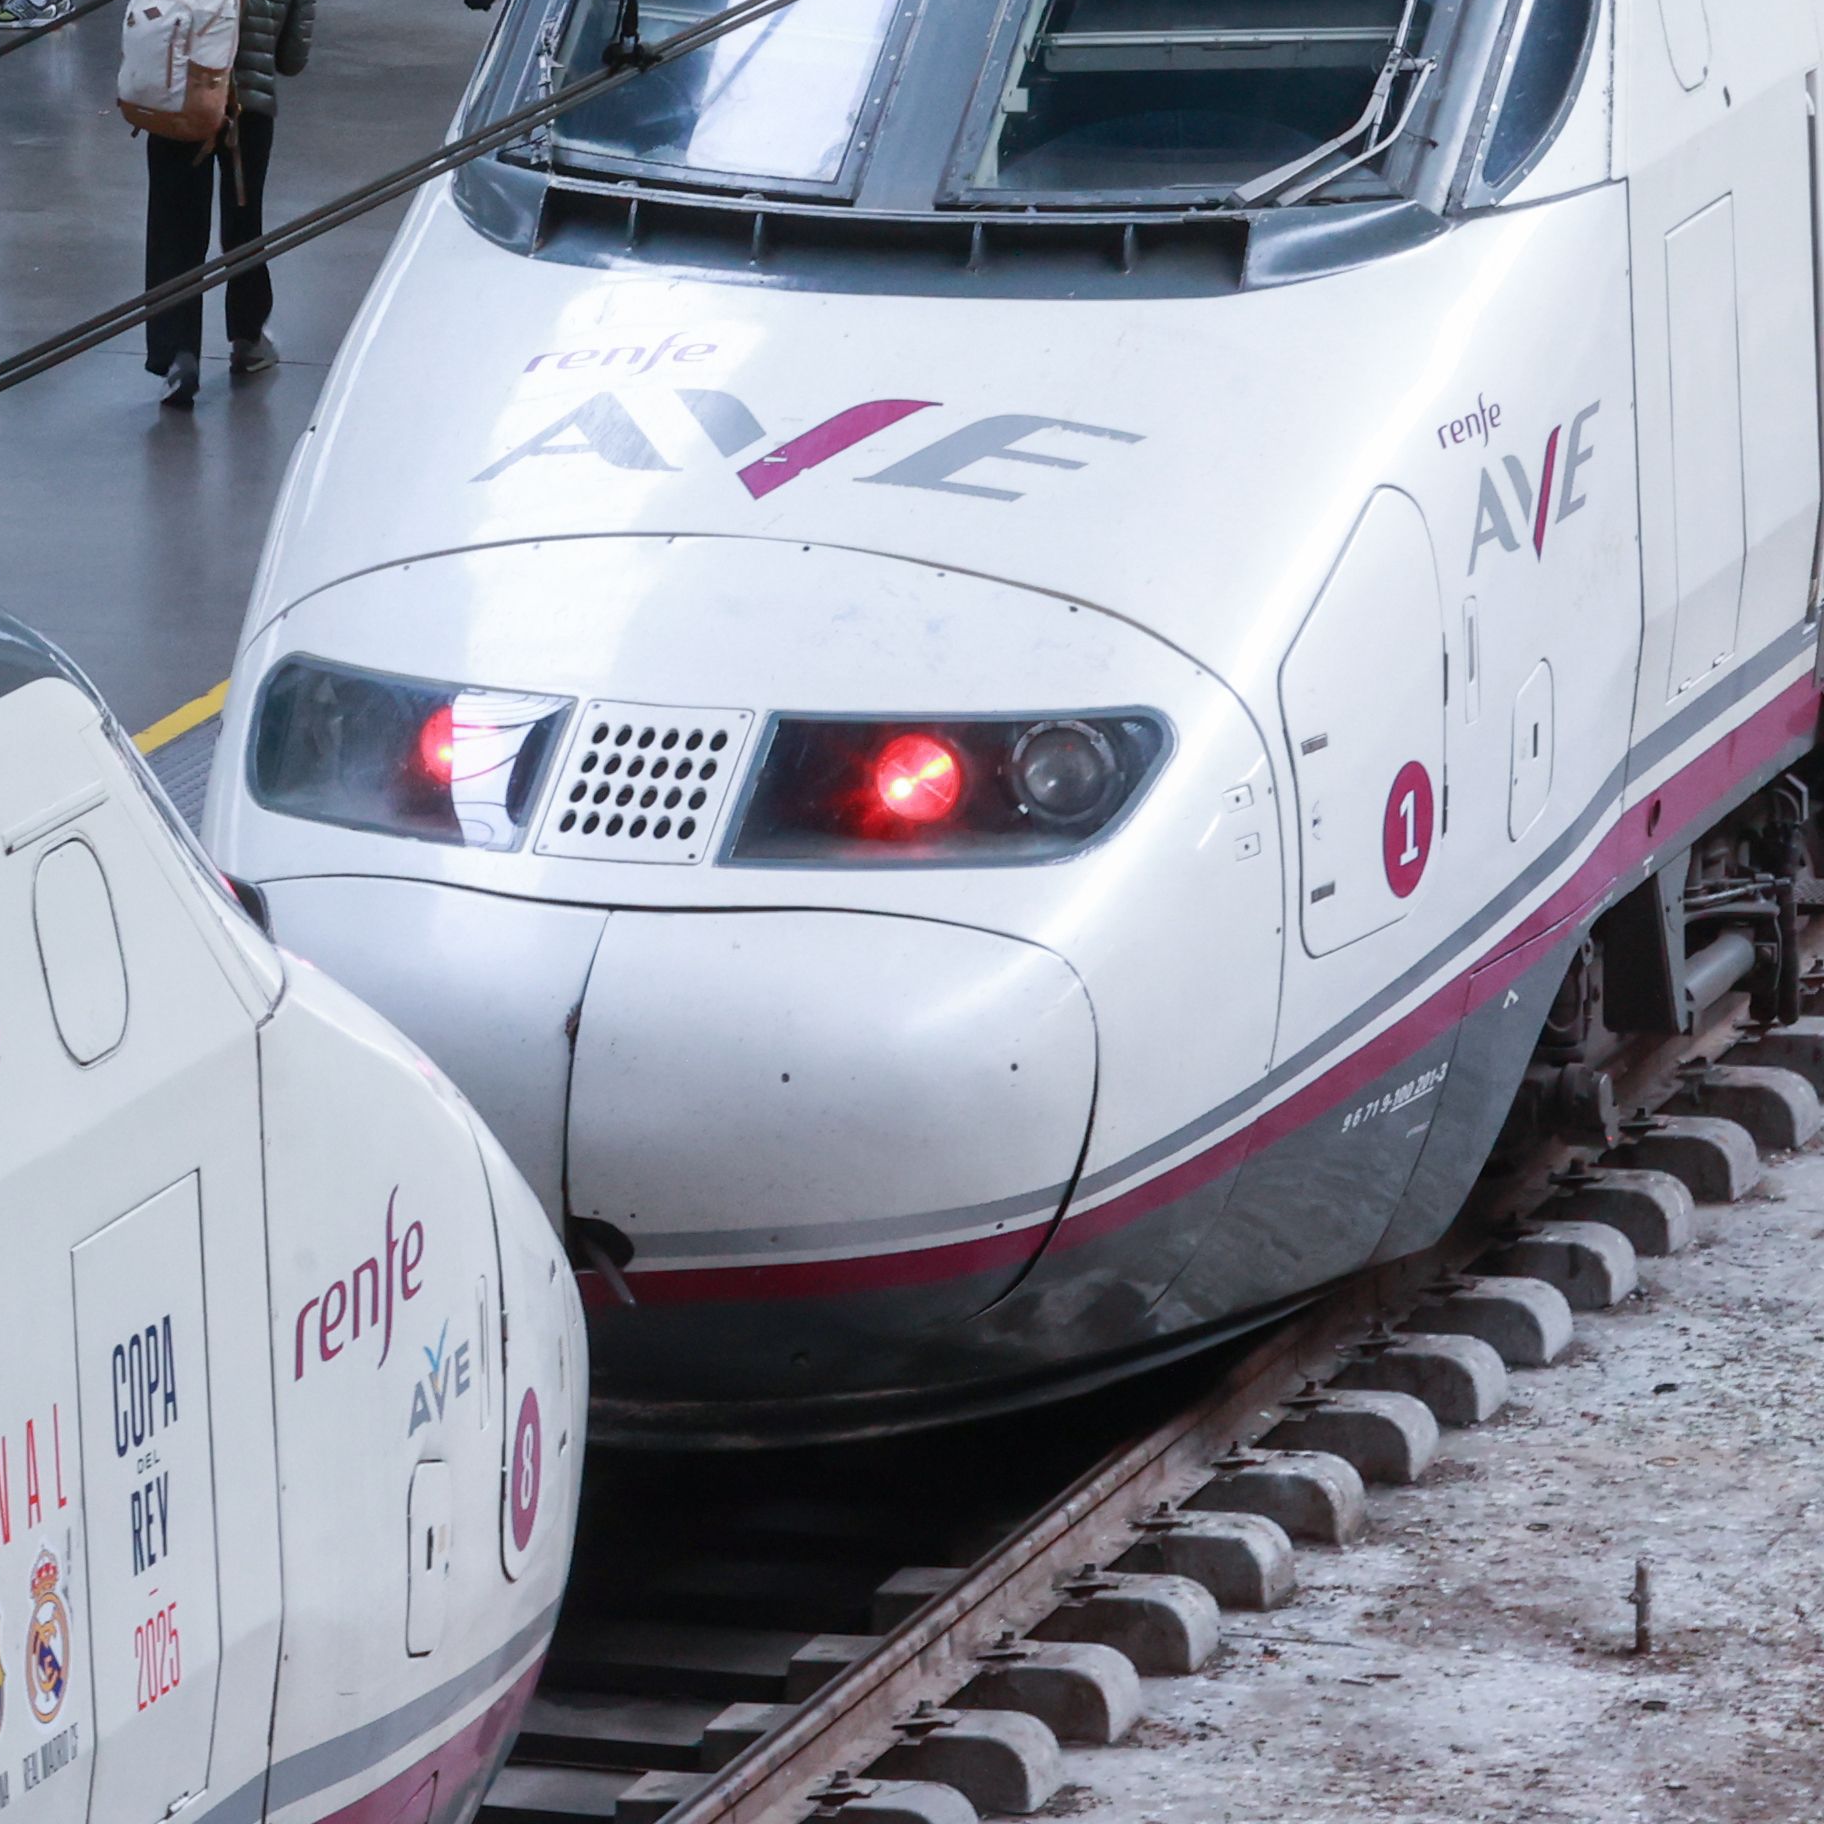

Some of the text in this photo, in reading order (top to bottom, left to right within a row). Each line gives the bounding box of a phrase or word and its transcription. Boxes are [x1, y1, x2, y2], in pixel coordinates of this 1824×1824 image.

[522, 332, 719, 376] renfe
[469, 388, 1148, 501] AVE
[1437, 392, 1502, 450] renfe
[1467, 399, 1601, 577] AVE
[1400, 789, 1419, 867] 1
[294, 1184, 424, 1382] renfe
[112, 1313, 178, 1458] COPA
[408, 1318, 471, 1439] AVE
[136, 1449, 161, 1475] DEL
[520, 1422, 534, 1511] 8
[130, 1471, 169, 1577] REY
[134, 1600, 182, 1713] 2025
